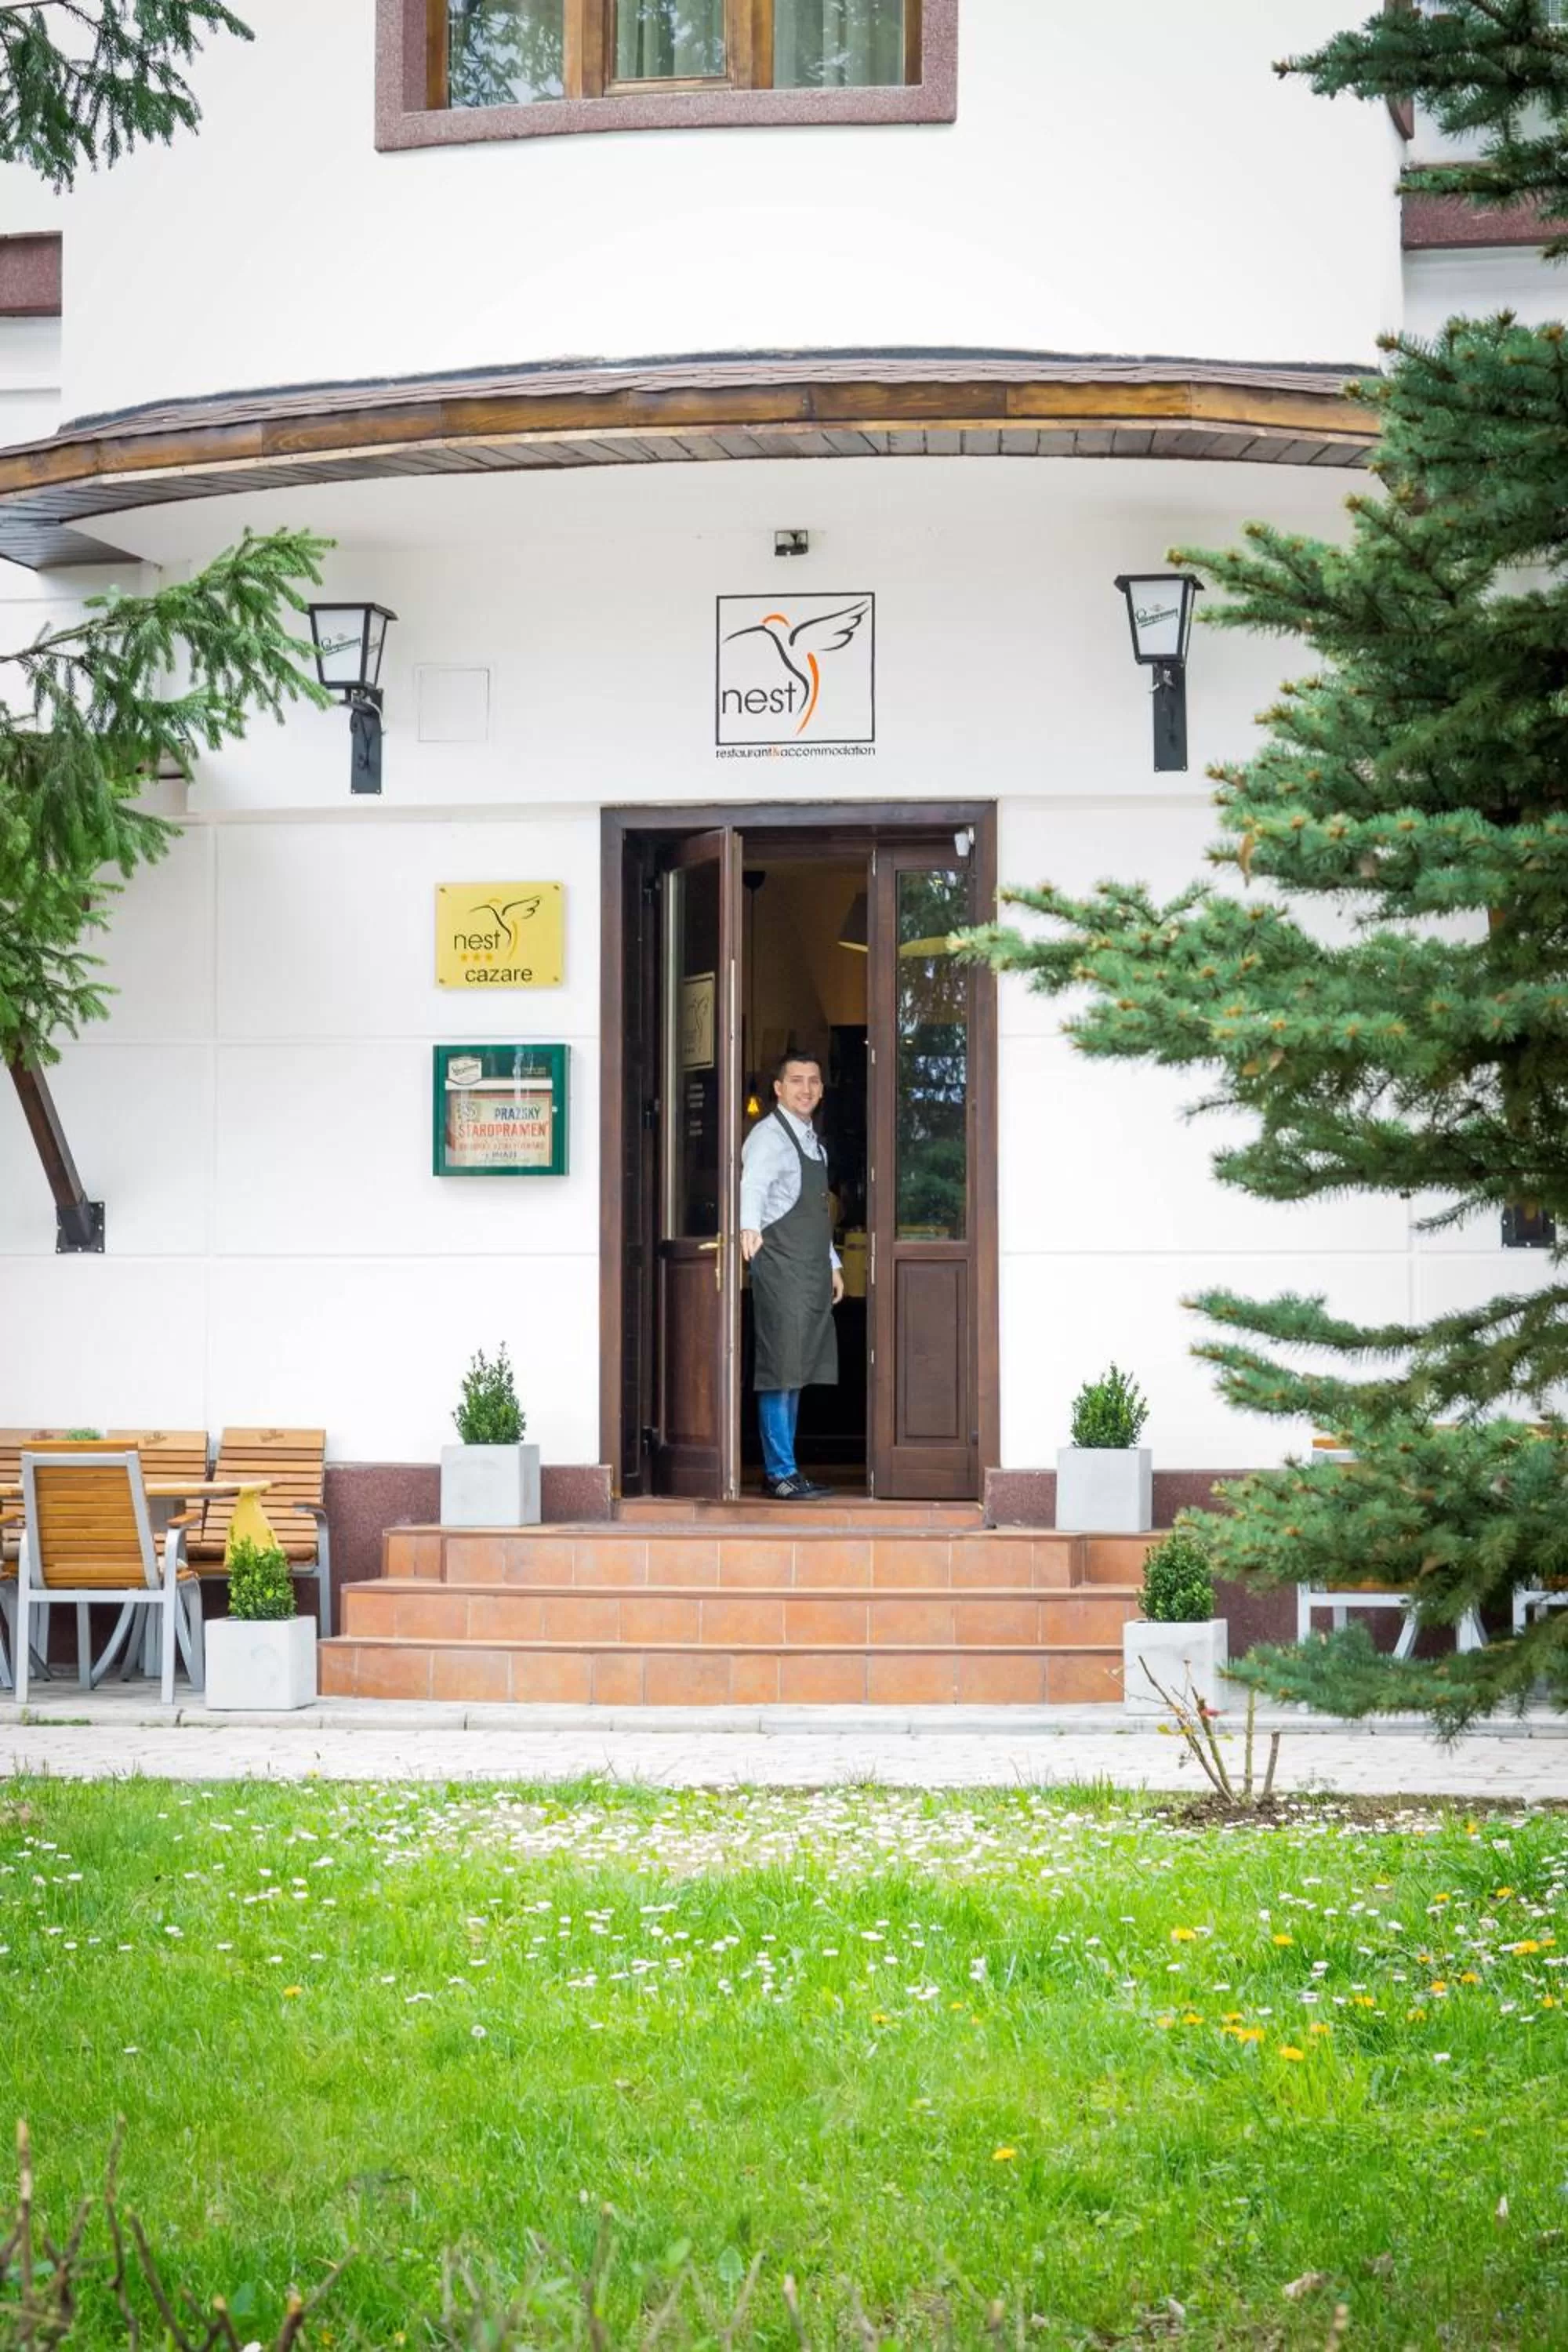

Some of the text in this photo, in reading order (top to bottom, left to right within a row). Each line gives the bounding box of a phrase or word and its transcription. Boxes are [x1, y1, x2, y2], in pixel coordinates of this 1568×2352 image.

[722, 681, 797, 714] nest
[453, 930, 501, 951] nest
[465, 967, 533, 982] cazare
